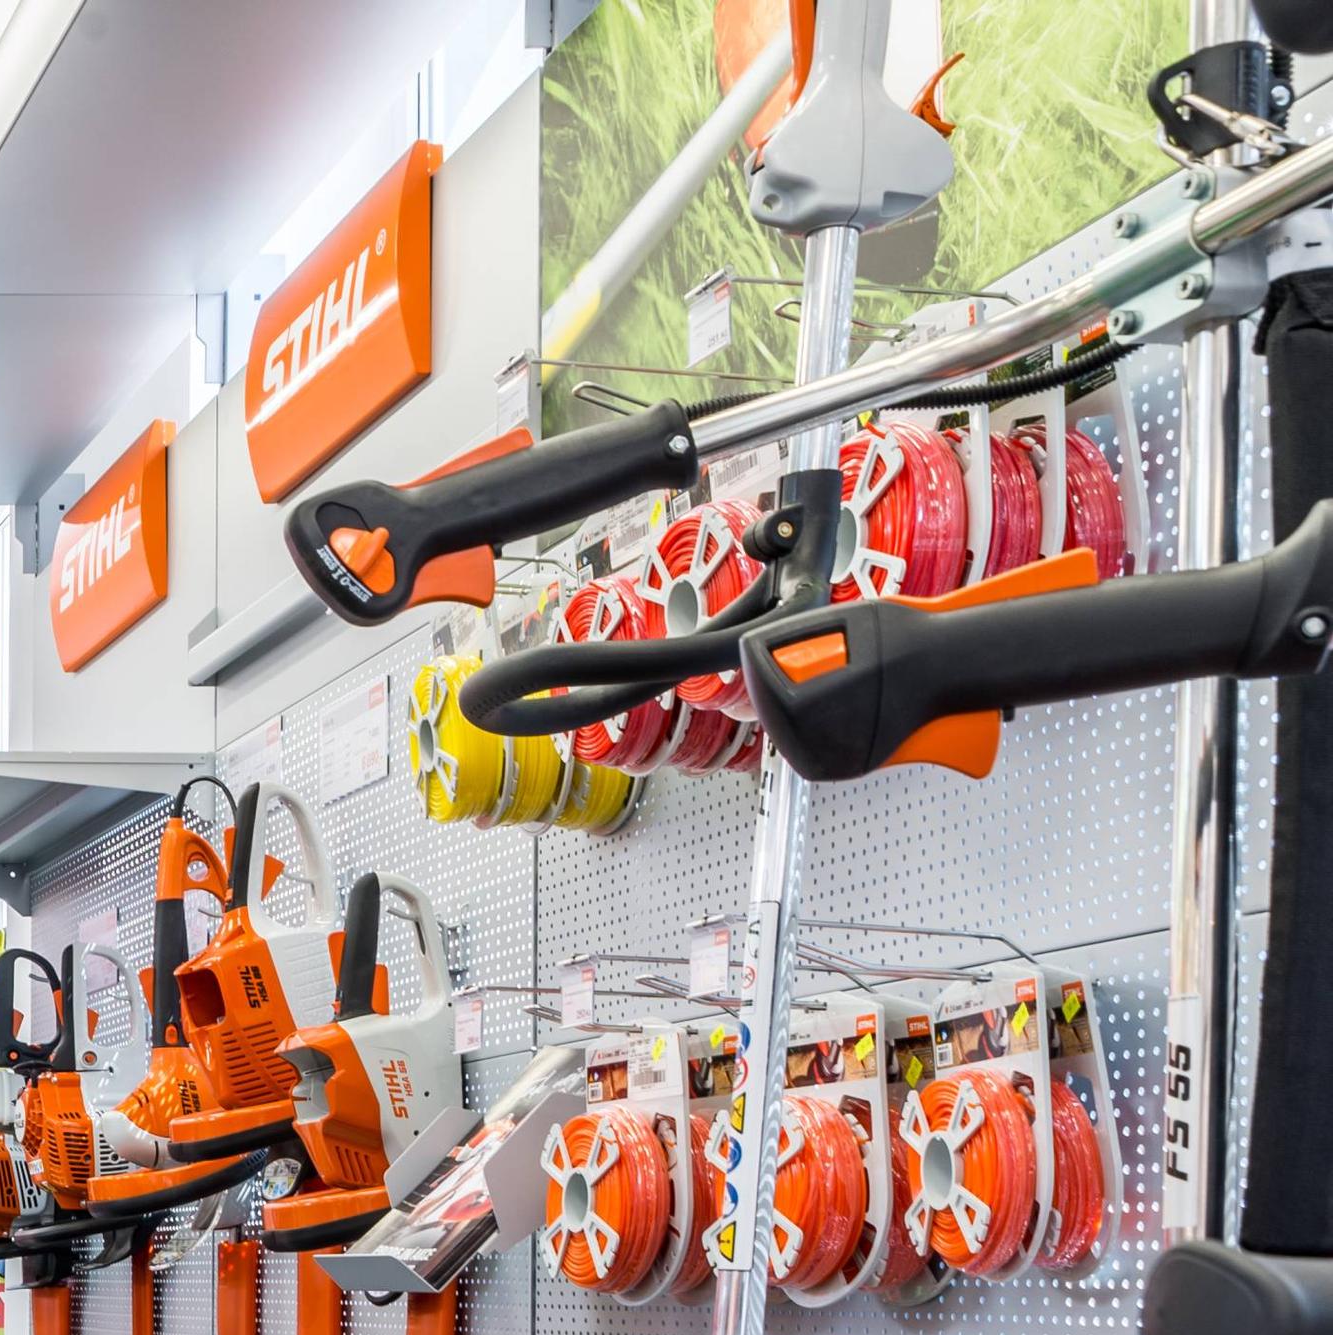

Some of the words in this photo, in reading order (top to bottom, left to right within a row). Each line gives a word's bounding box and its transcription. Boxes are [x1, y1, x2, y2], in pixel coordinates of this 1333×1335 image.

[262, 246, 370, 395] STIHL
[59, 494, 132, 615] STIHL
[239, 966, 261, 1009] STIHL
[381, 1060, 409, 1119] STIHL
[401, 1076, 413, 1097] HSA
[1167, 1041, 1192, 1102] 55
[1165, 1115, 1189, 1183] FS
